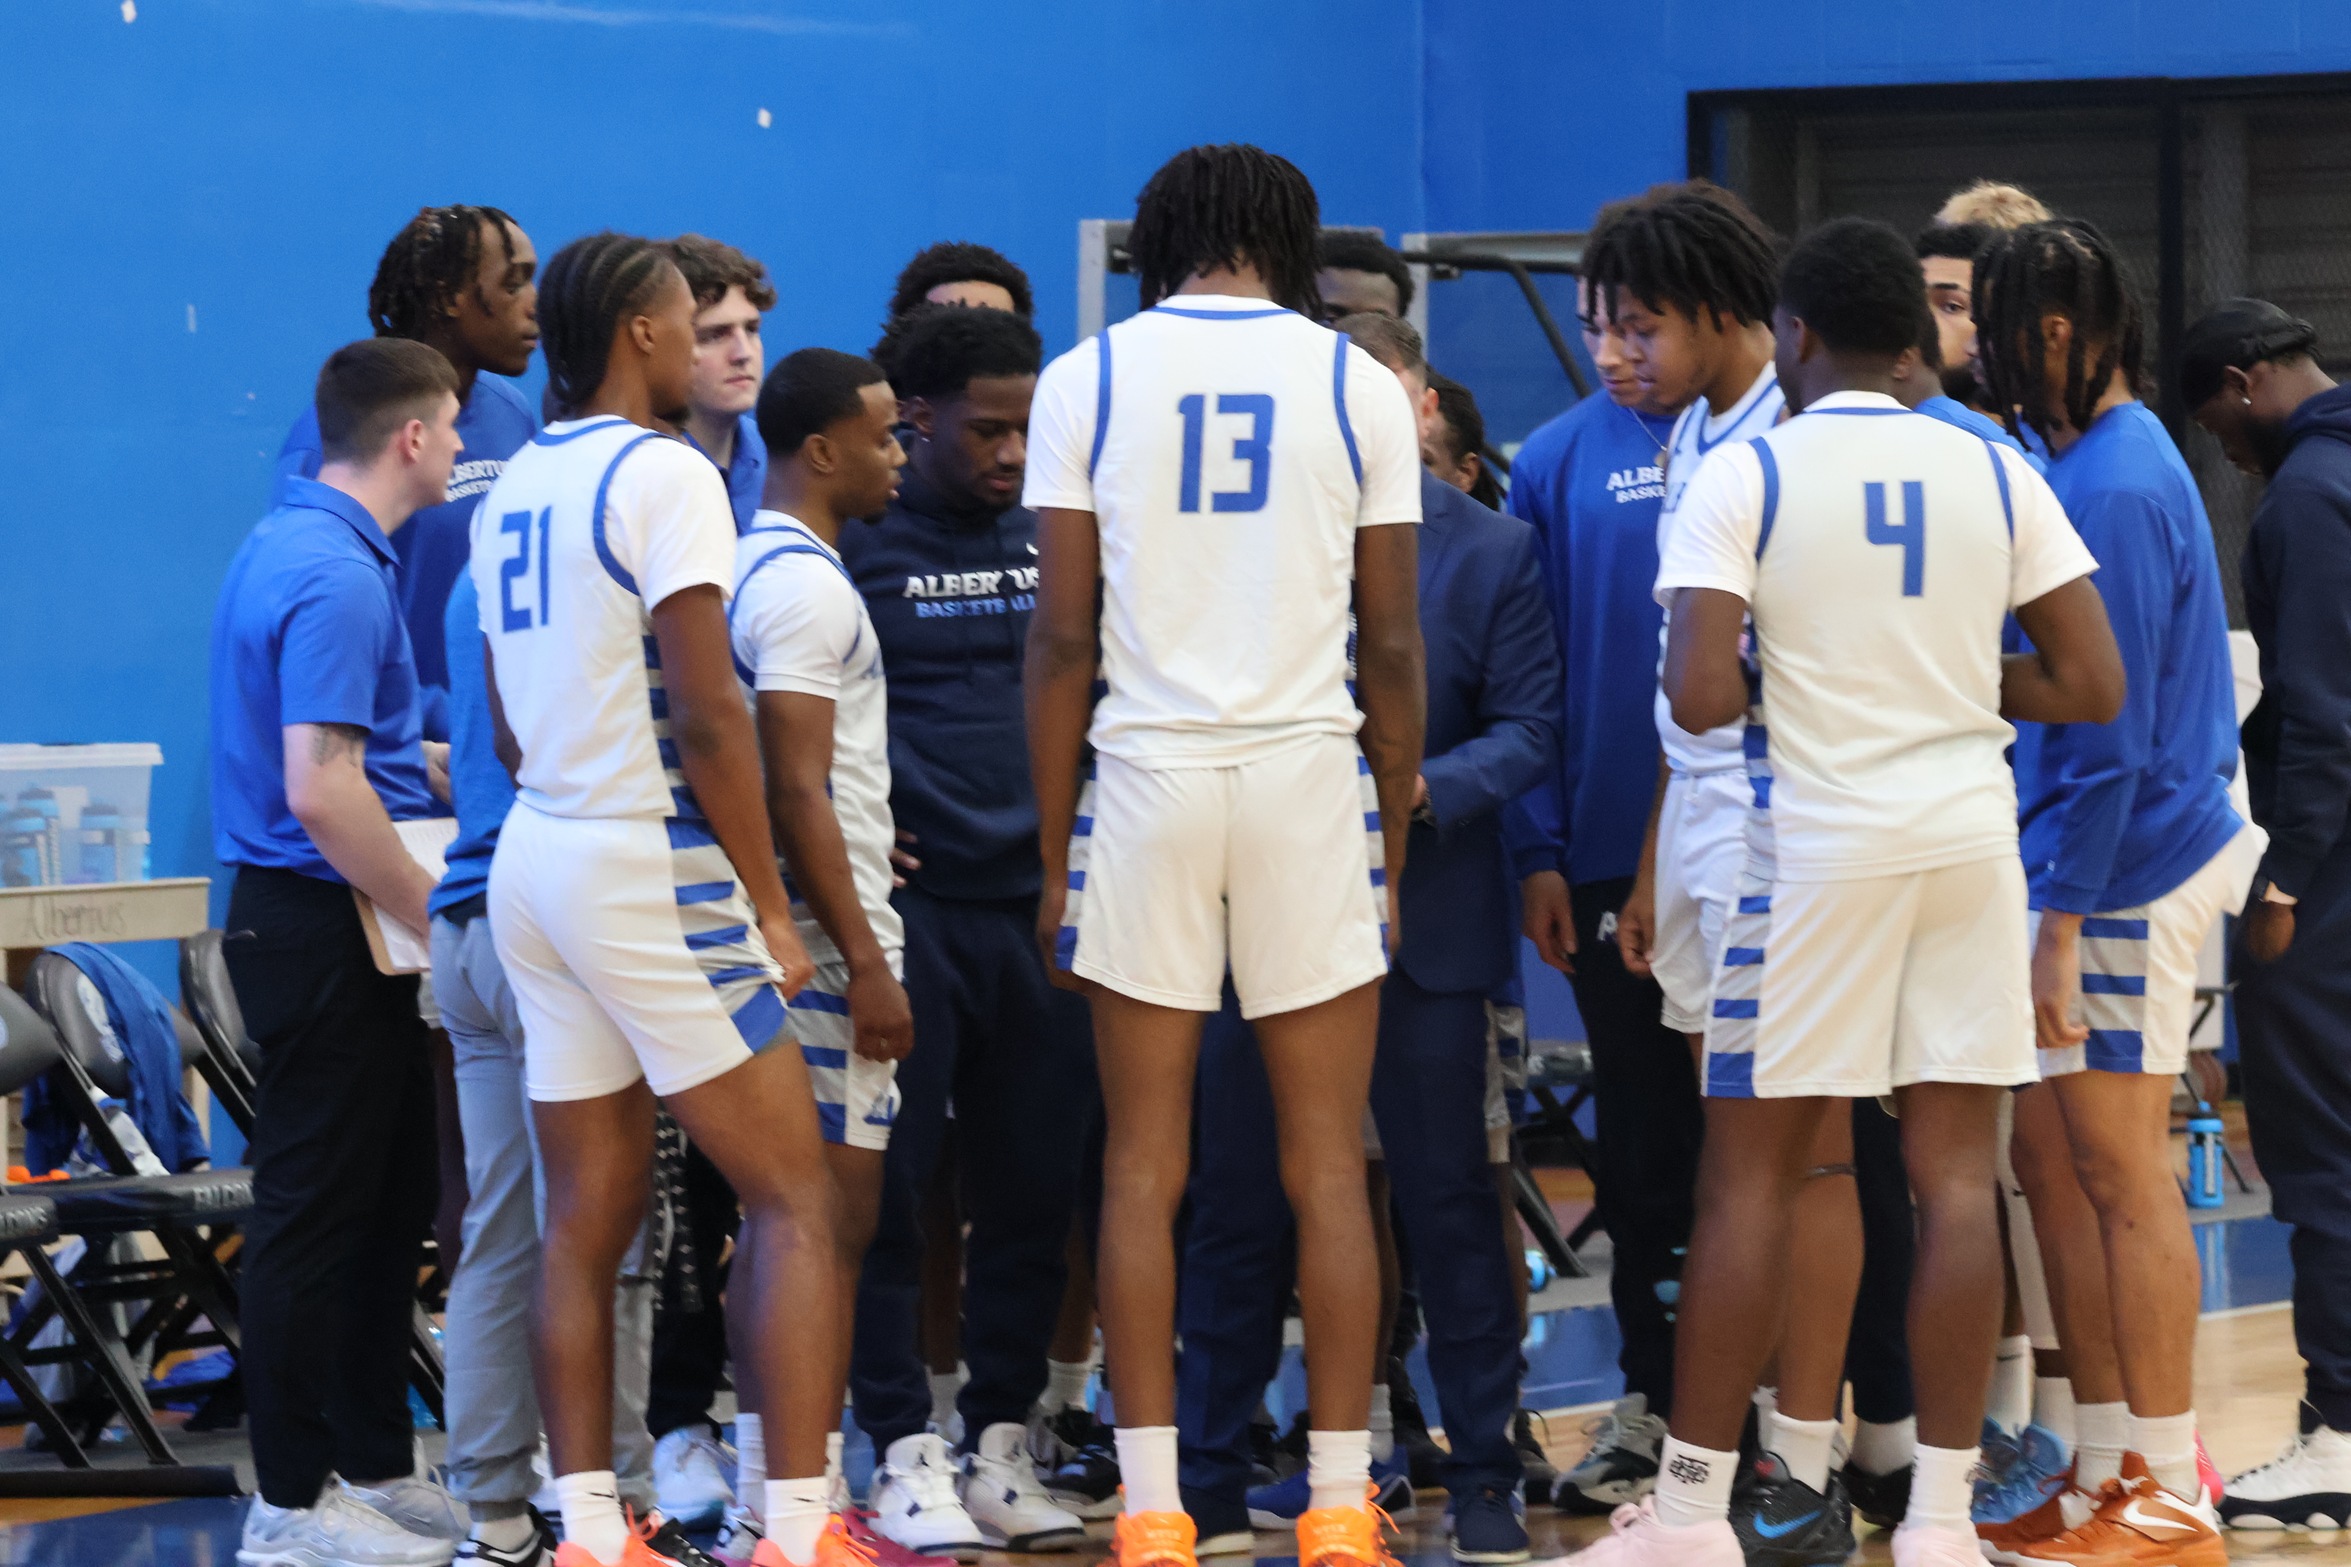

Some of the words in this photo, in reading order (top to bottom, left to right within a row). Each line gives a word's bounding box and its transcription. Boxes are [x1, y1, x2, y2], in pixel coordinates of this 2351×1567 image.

[1177, 393, 1275, 513] 13
[1605, 466, 1665, 491] ALBE
[1615, 484, 1667, 503] BASKE
[500, 504, 552, 634] 21
[1864, 480, 1925, 597] 4
